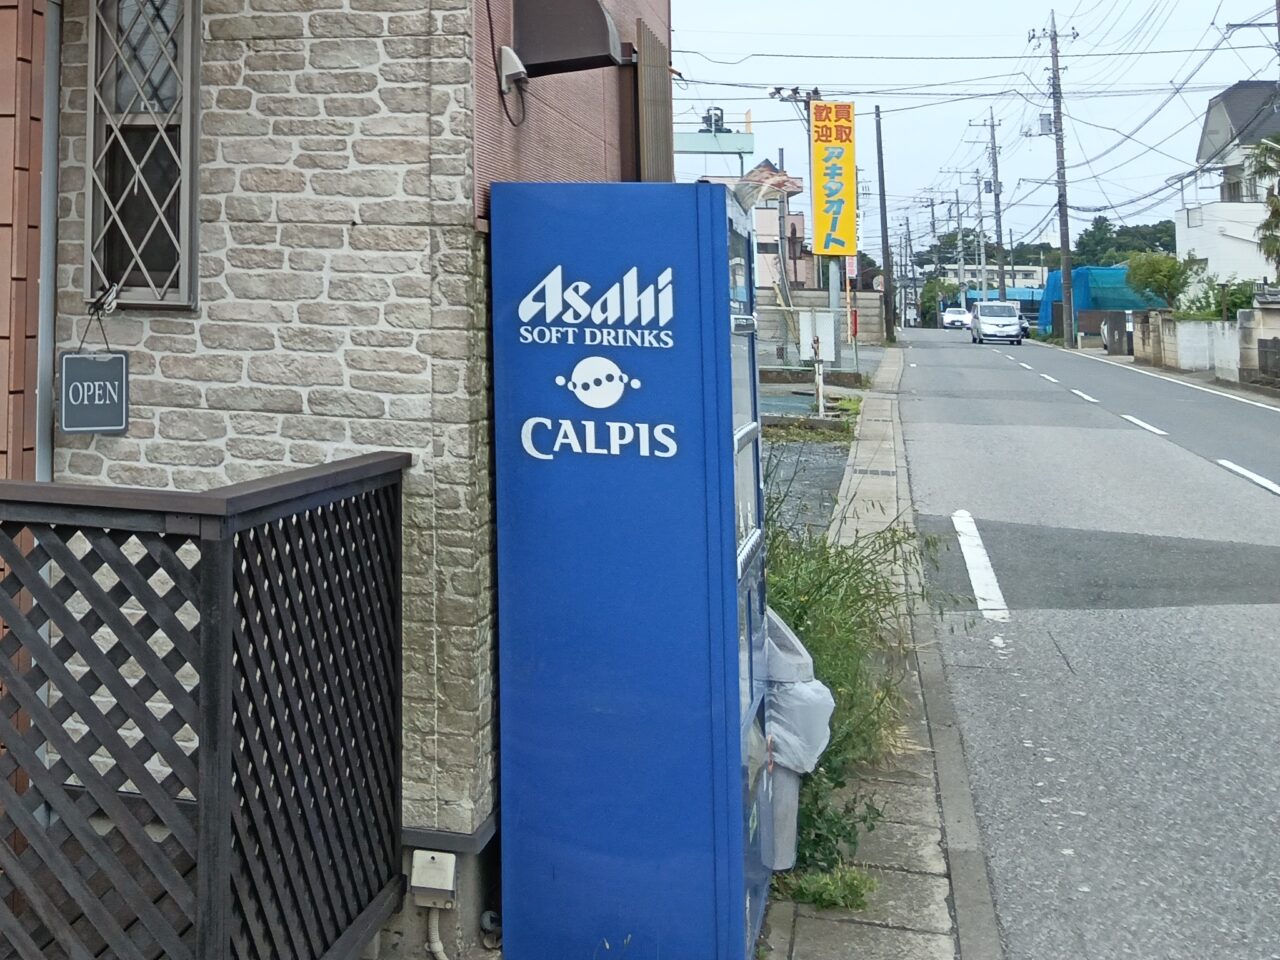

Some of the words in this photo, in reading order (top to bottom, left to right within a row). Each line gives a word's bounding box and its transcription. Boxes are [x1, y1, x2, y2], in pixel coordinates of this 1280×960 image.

[822, 146, 846, 249] アキタオート
[518, 264, 674, 327] Asahi
[520, 326, 579, 345] SOFT
[584, 327, 674, 349] DRINKS
[69, 381, 119, 405] OPEN
[521, 416, 678, 460] CALPIS
